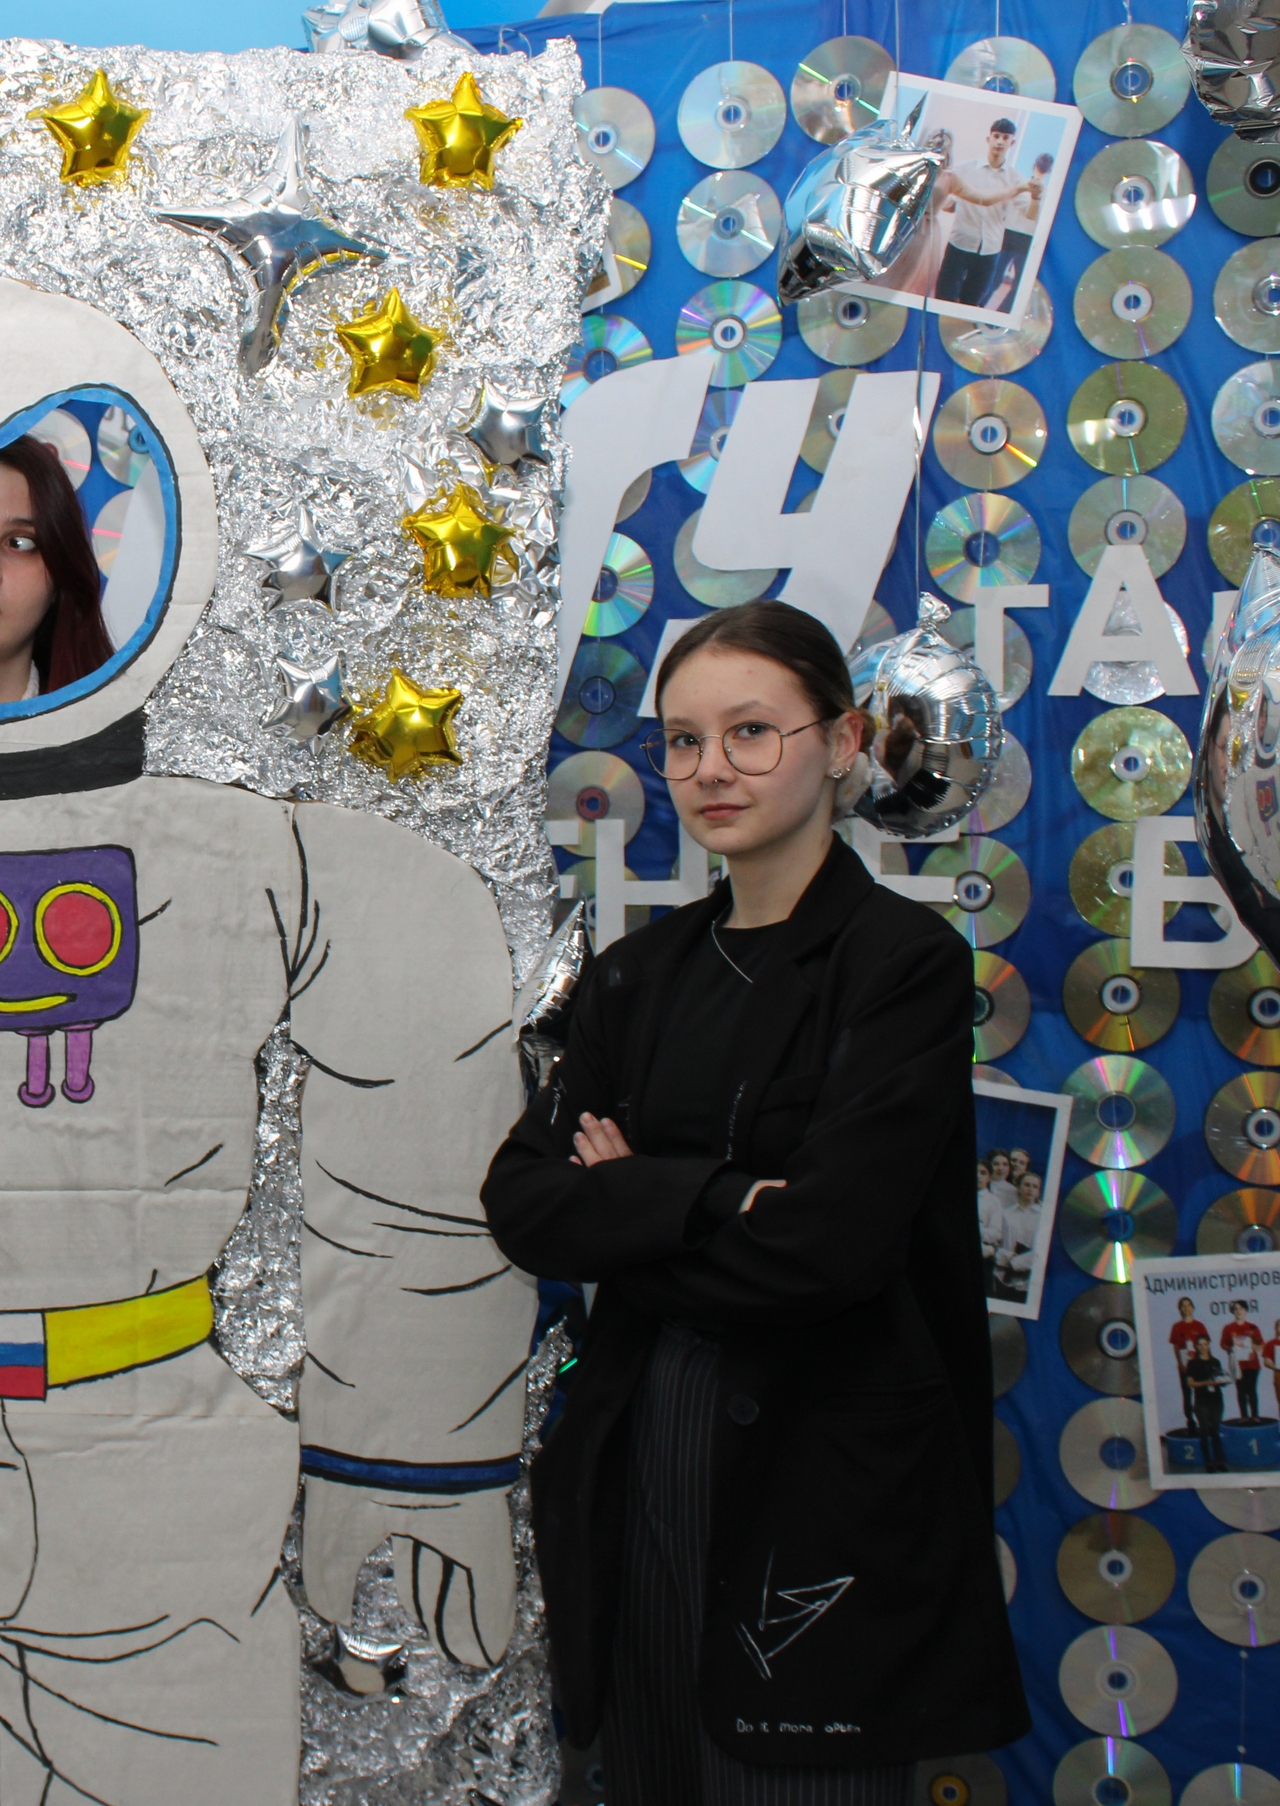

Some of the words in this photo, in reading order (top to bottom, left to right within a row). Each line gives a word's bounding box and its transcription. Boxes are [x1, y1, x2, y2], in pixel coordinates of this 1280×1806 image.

[1184, 1445, 1195, 1460] 2
[1248, 1438, 1259, 1456] 1
[736, 1717, 754, 1733] Do
[779, 1721, 814, 1734] more
